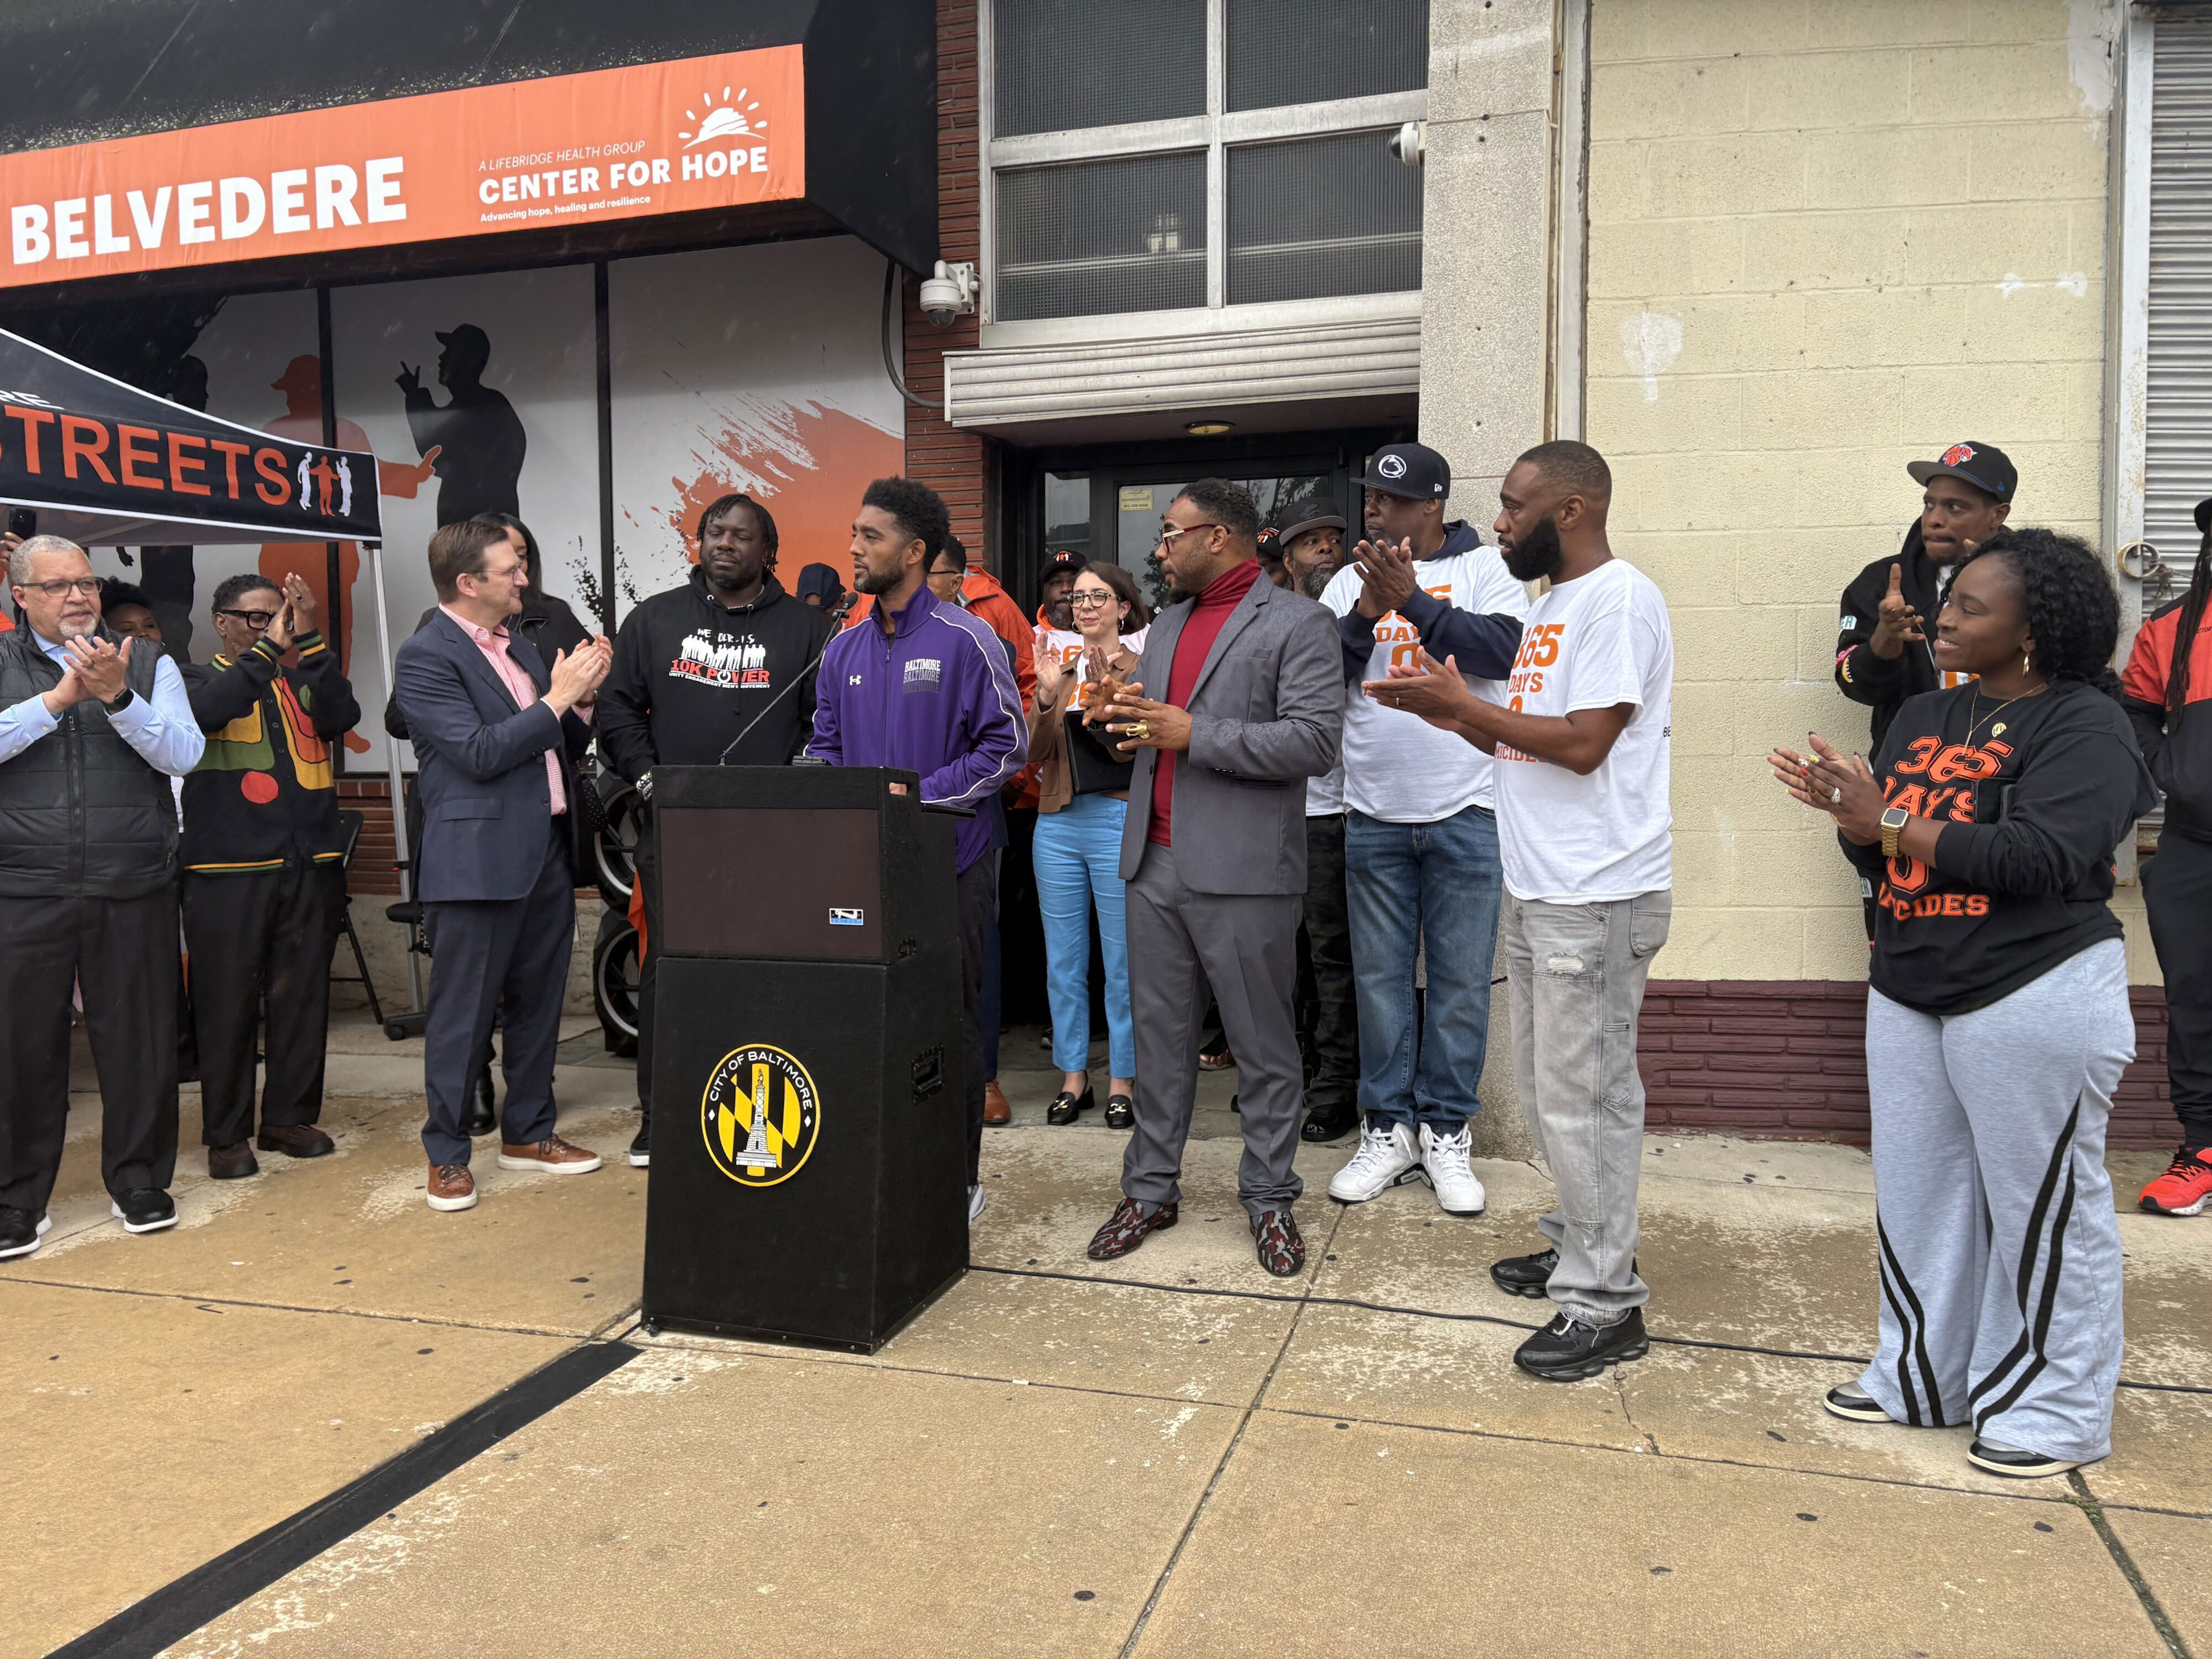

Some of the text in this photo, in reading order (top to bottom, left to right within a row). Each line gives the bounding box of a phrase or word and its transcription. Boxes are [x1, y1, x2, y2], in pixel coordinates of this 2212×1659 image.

[479, 141, 645, 172] A LIFEBRIDGE HEALTH GROUP
[479, 147, 768, 204] CENTER FOR HOPE
[11, 157, 407, 264] BELVEDERE
[480, 195, 650, 223] Advancing hope, healing and resilience
[0, 405, 291, 505] TREETS
[697, 628, 712, 638] WE
[1376, 625, 1419, 643] DAY
[670, 659, 770, 683] 10K POWER
[903, 669, 940, 684] BALTIMORE
[904, 659, 941, 673] BALTIMORE
[685, 674, 721, 687] ENGAGEMENT
[1509, 672, 1543, 693] DAYS
[1895, 736, 2014, 783] 365
[1879, 882, 1990, 920] CIDES
[710, 1051, 813, 1111] CITY OF BALTIMORE
